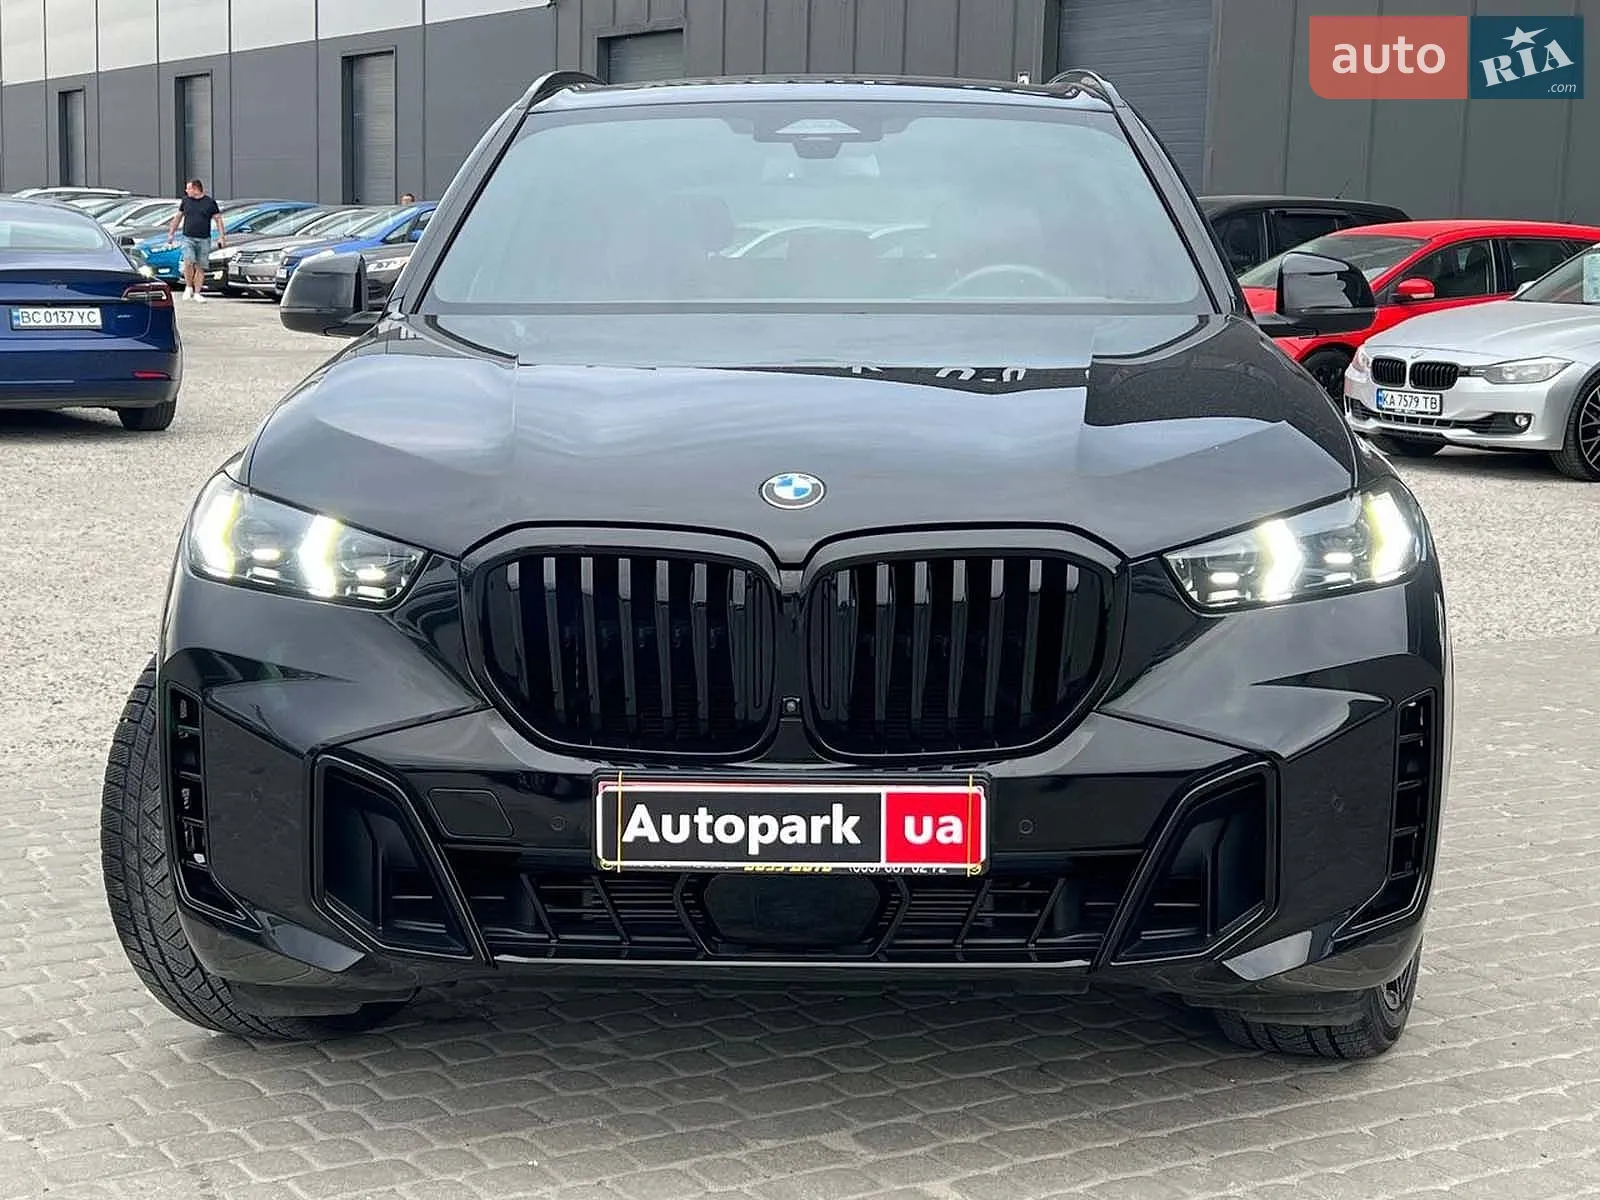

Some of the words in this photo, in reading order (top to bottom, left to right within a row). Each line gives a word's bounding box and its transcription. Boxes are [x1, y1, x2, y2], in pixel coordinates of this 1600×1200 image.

[21, 311, 41, 324] BC
[44, 311, 74, 324] 0137
[75, 311, 97, 324] YC
[1383, 392, 1396, 406] KA
[1397, 394, 1420, 408] 7579
[1422, 396, 1438, 410] TB
[622, 803, 862, 855] Autopark
[903, 814, 964, 844] ua
